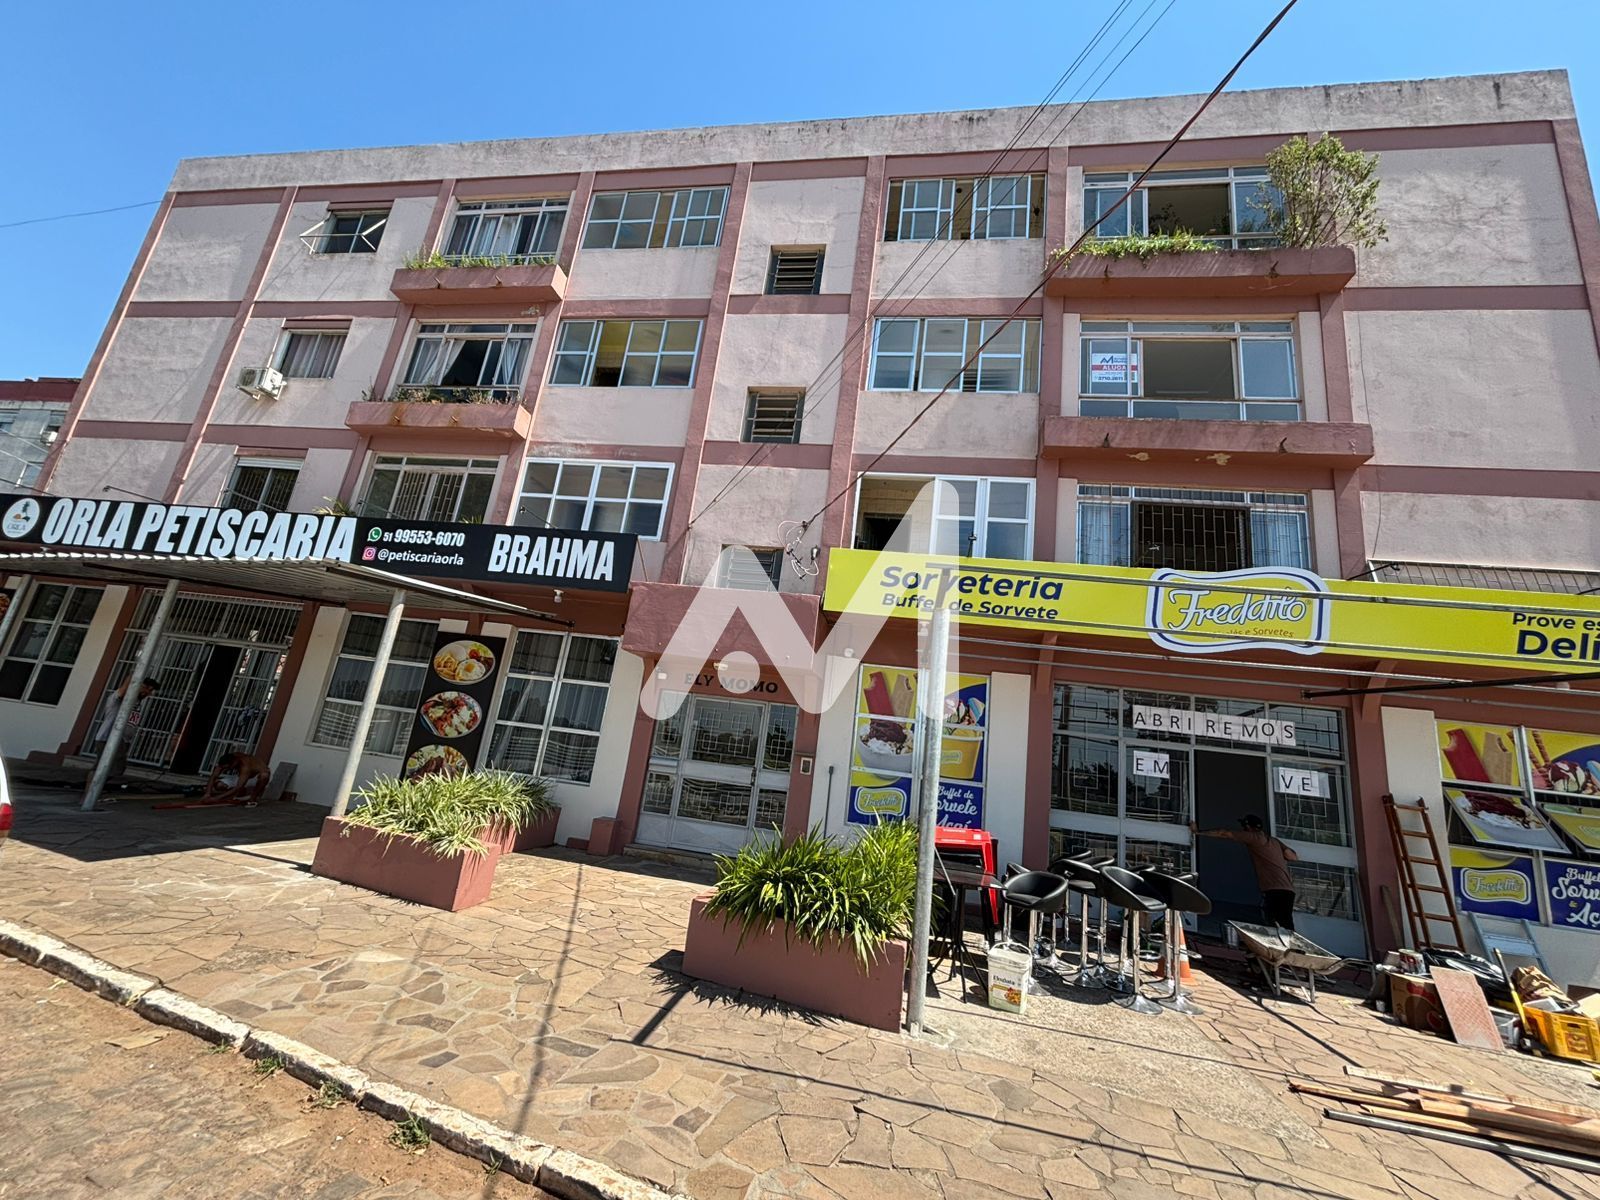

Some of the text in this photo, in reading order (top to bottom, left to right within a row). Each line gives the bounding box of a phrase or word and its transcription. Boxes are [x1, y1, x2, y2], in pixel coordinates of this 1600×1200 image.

[42, 498, 358, 564] ORLA PETISCARIA
[383, 529, 466, 547] 51 99553-6070
[377, 548, 464, 565] @petiscariaorla
[487, 533, 615, 581] BRAHMA
[882, 593, 1059, 619] Buffe de Sorvete
[1512, 612, 1576, 629] Prove
[1252, 627, 1295, 638] Sorvetes
[684, 673, 778, 694] ELY MOMO
[1136, 757, 1312, 793] EM VE
[937, 799, 978, 815] orvete
